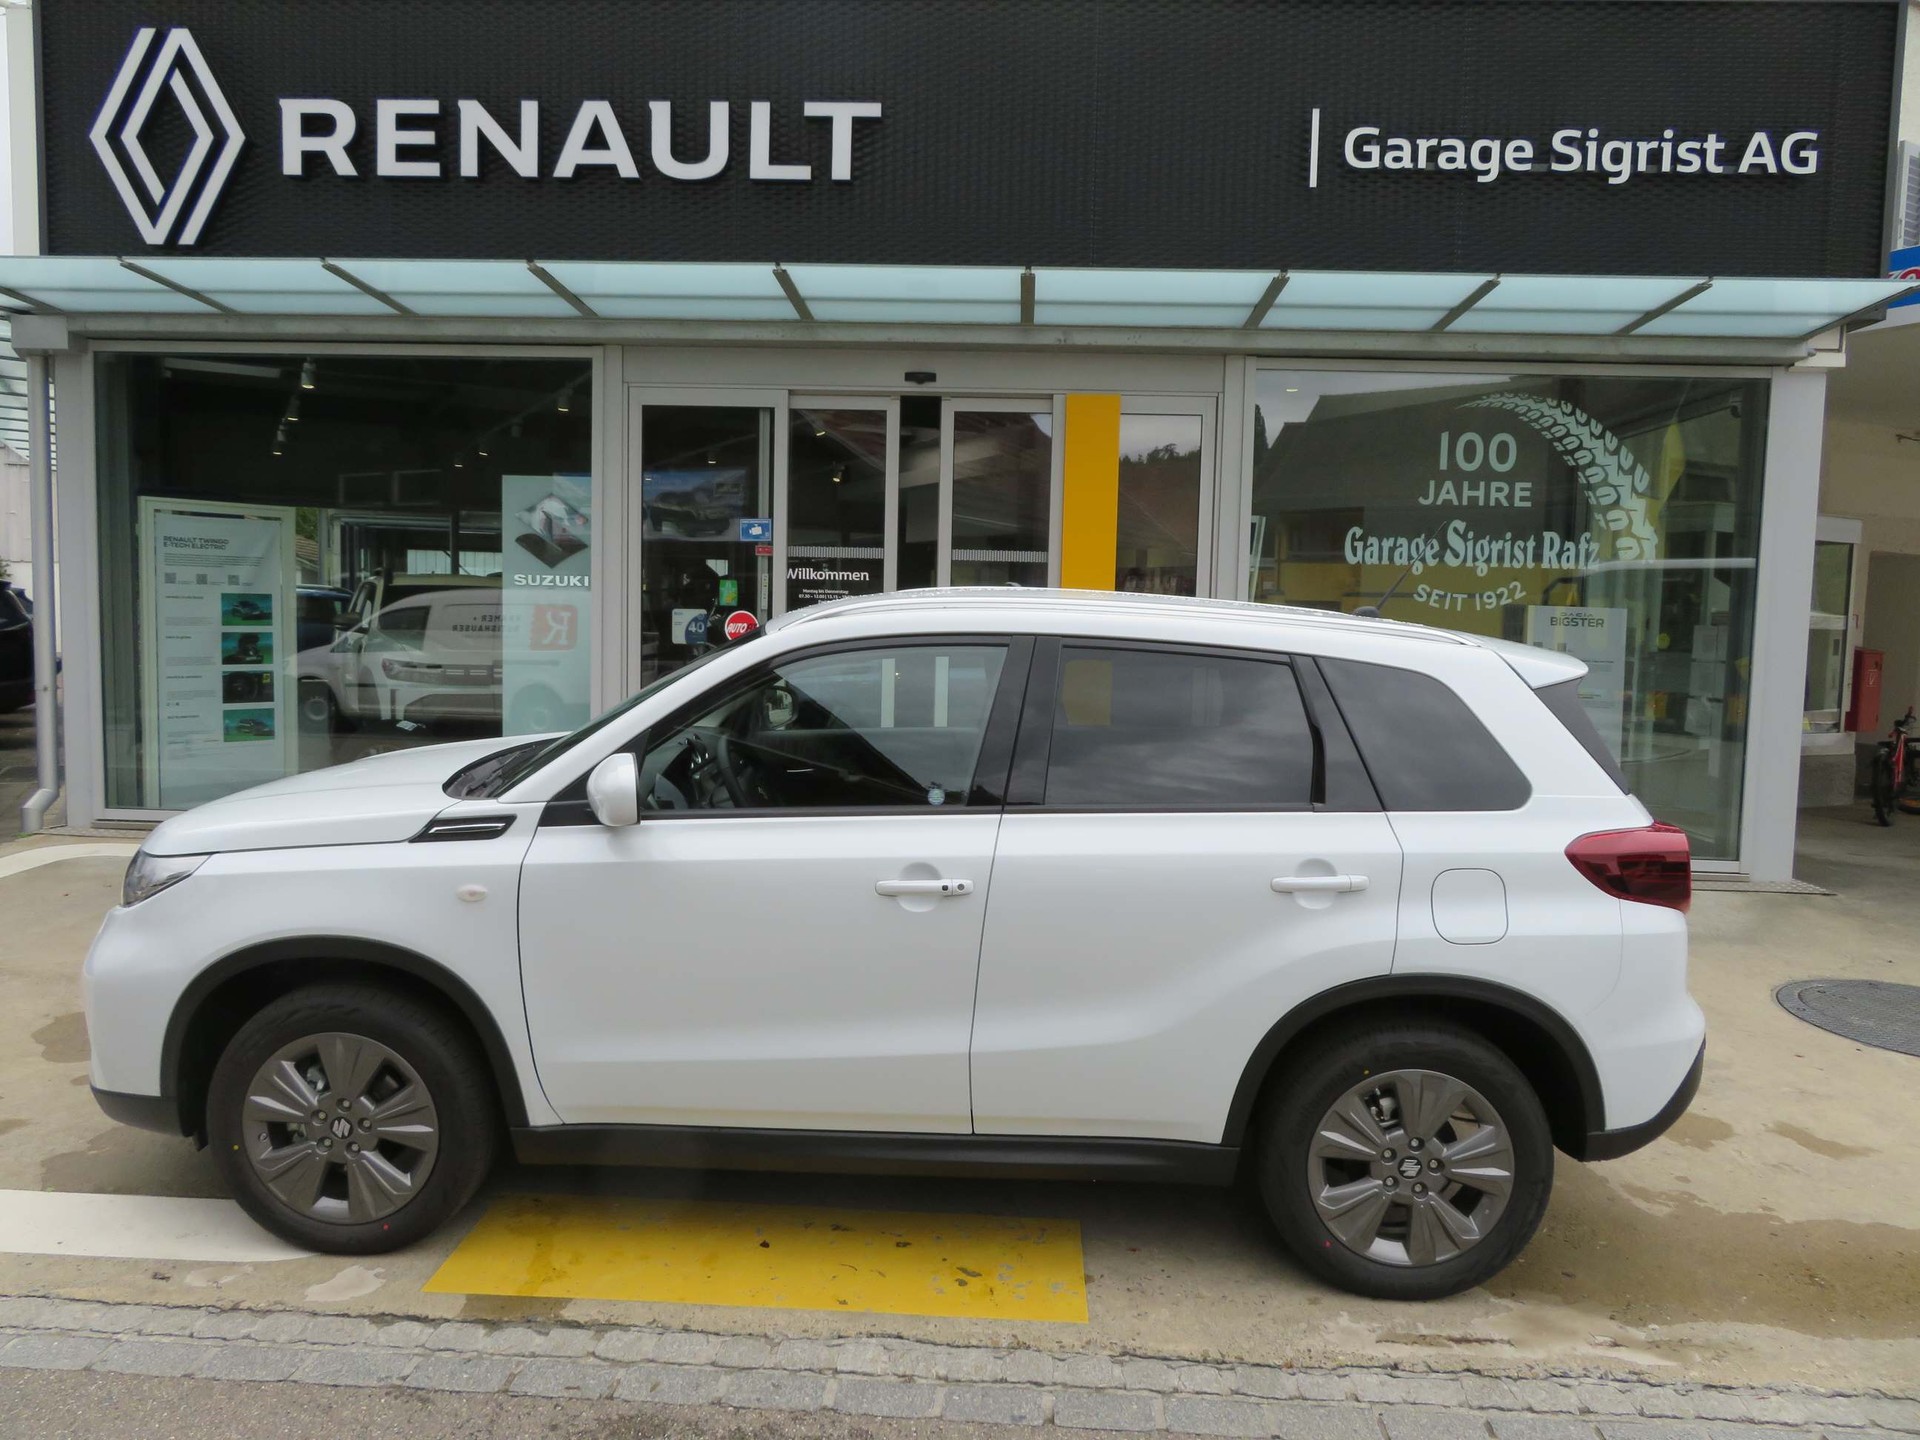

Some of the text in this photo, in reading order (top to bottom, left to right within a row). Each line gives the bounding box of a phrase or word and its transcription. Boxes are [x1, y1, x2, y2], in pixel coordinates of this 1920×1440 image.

[279, 98, 882, 181] RENAULT
[1344, 127, 1820, 184] Garage Sigrist AG
[1439, 431, 1518, 473] 100
[1417, 480, 1533, 508] JAHRE
[163, 535, 197, 543] RENAULT
[1344, 518, 1601, 577] Garage Sigrist Rafz
[513, 574, 589, 587] SUZUKI
[787, 567, 870, 580] Willkommen
[1413, 581, 1527, 612] SEIT 1922
[688, 621, 705, 633] 40
[727, 622, 748, 634] AUTO
[1549, 616, 1605, 629] BIGSTER
